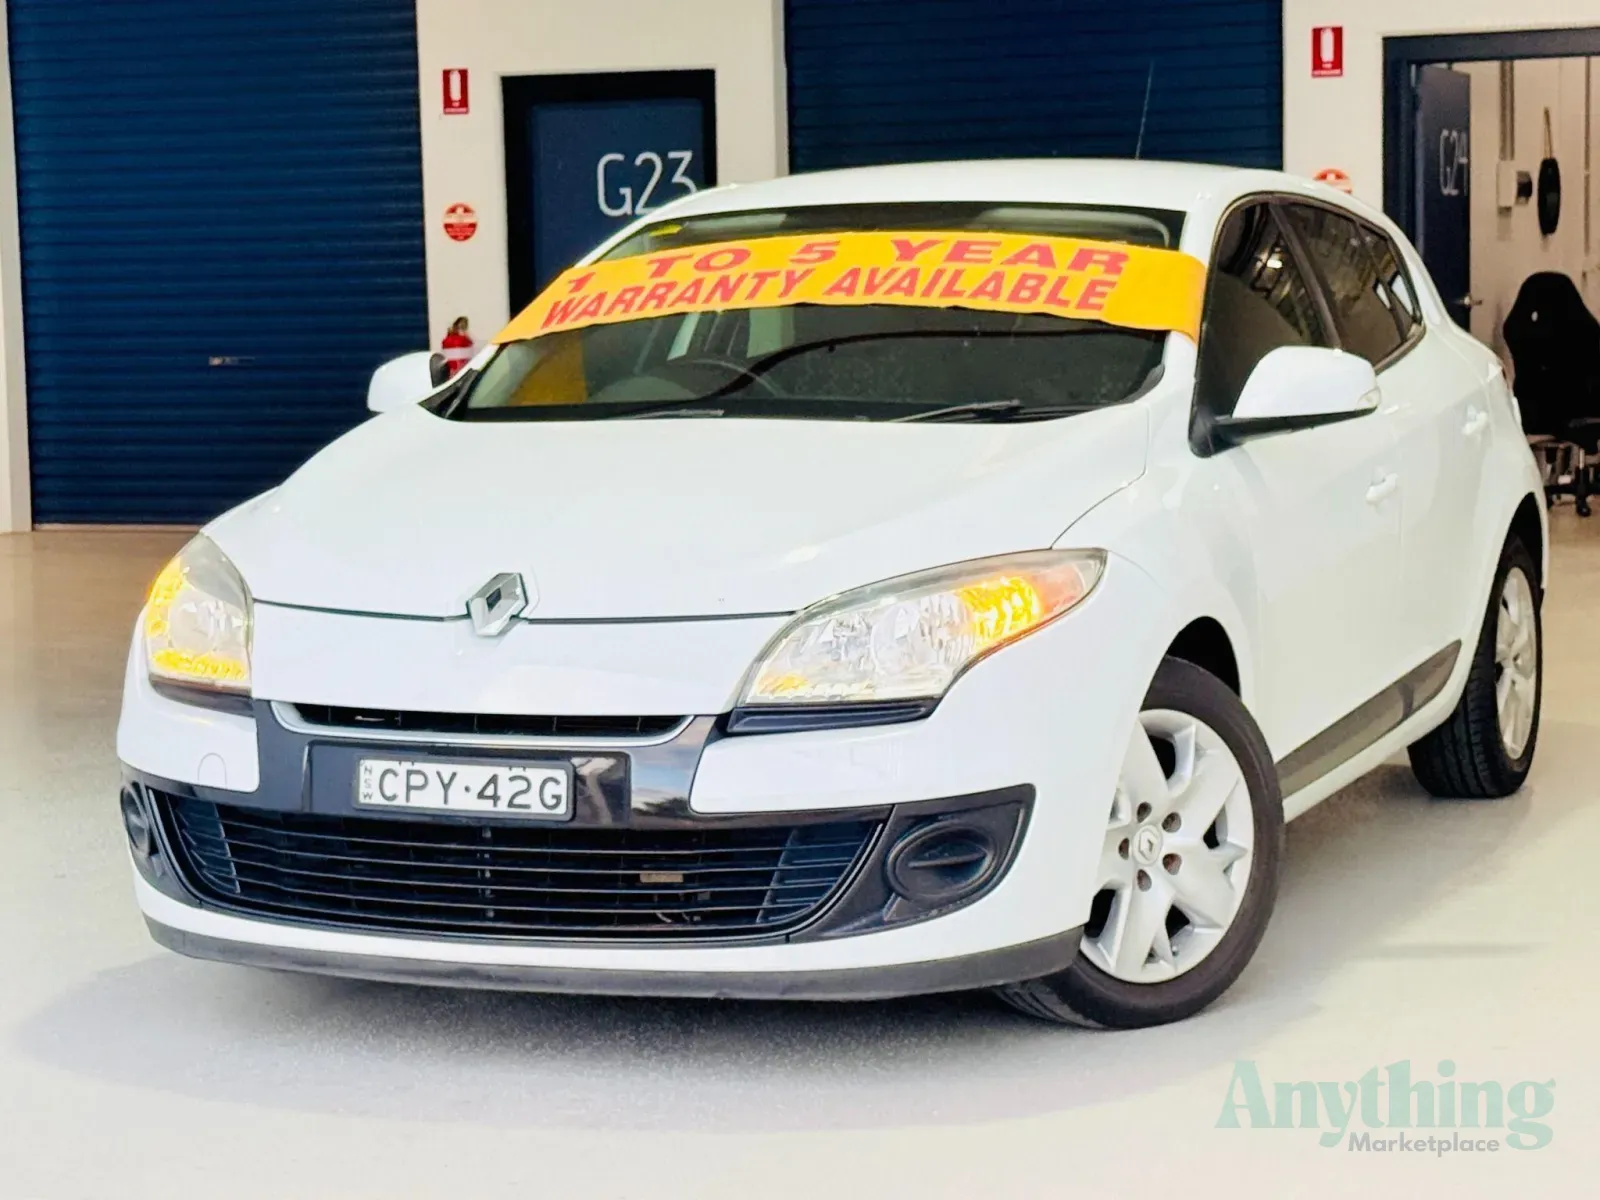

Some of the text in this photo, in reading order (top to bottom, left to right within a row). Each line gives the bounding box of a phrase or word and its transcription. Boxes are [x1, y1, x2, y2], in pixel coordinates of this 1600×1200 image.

[597, 151, 698, 217] G23
[542, 266, 1118, 327] WARRANTY AVAILABLE
[569, 239, 1130, 293] 1 TO 5 YEAR
